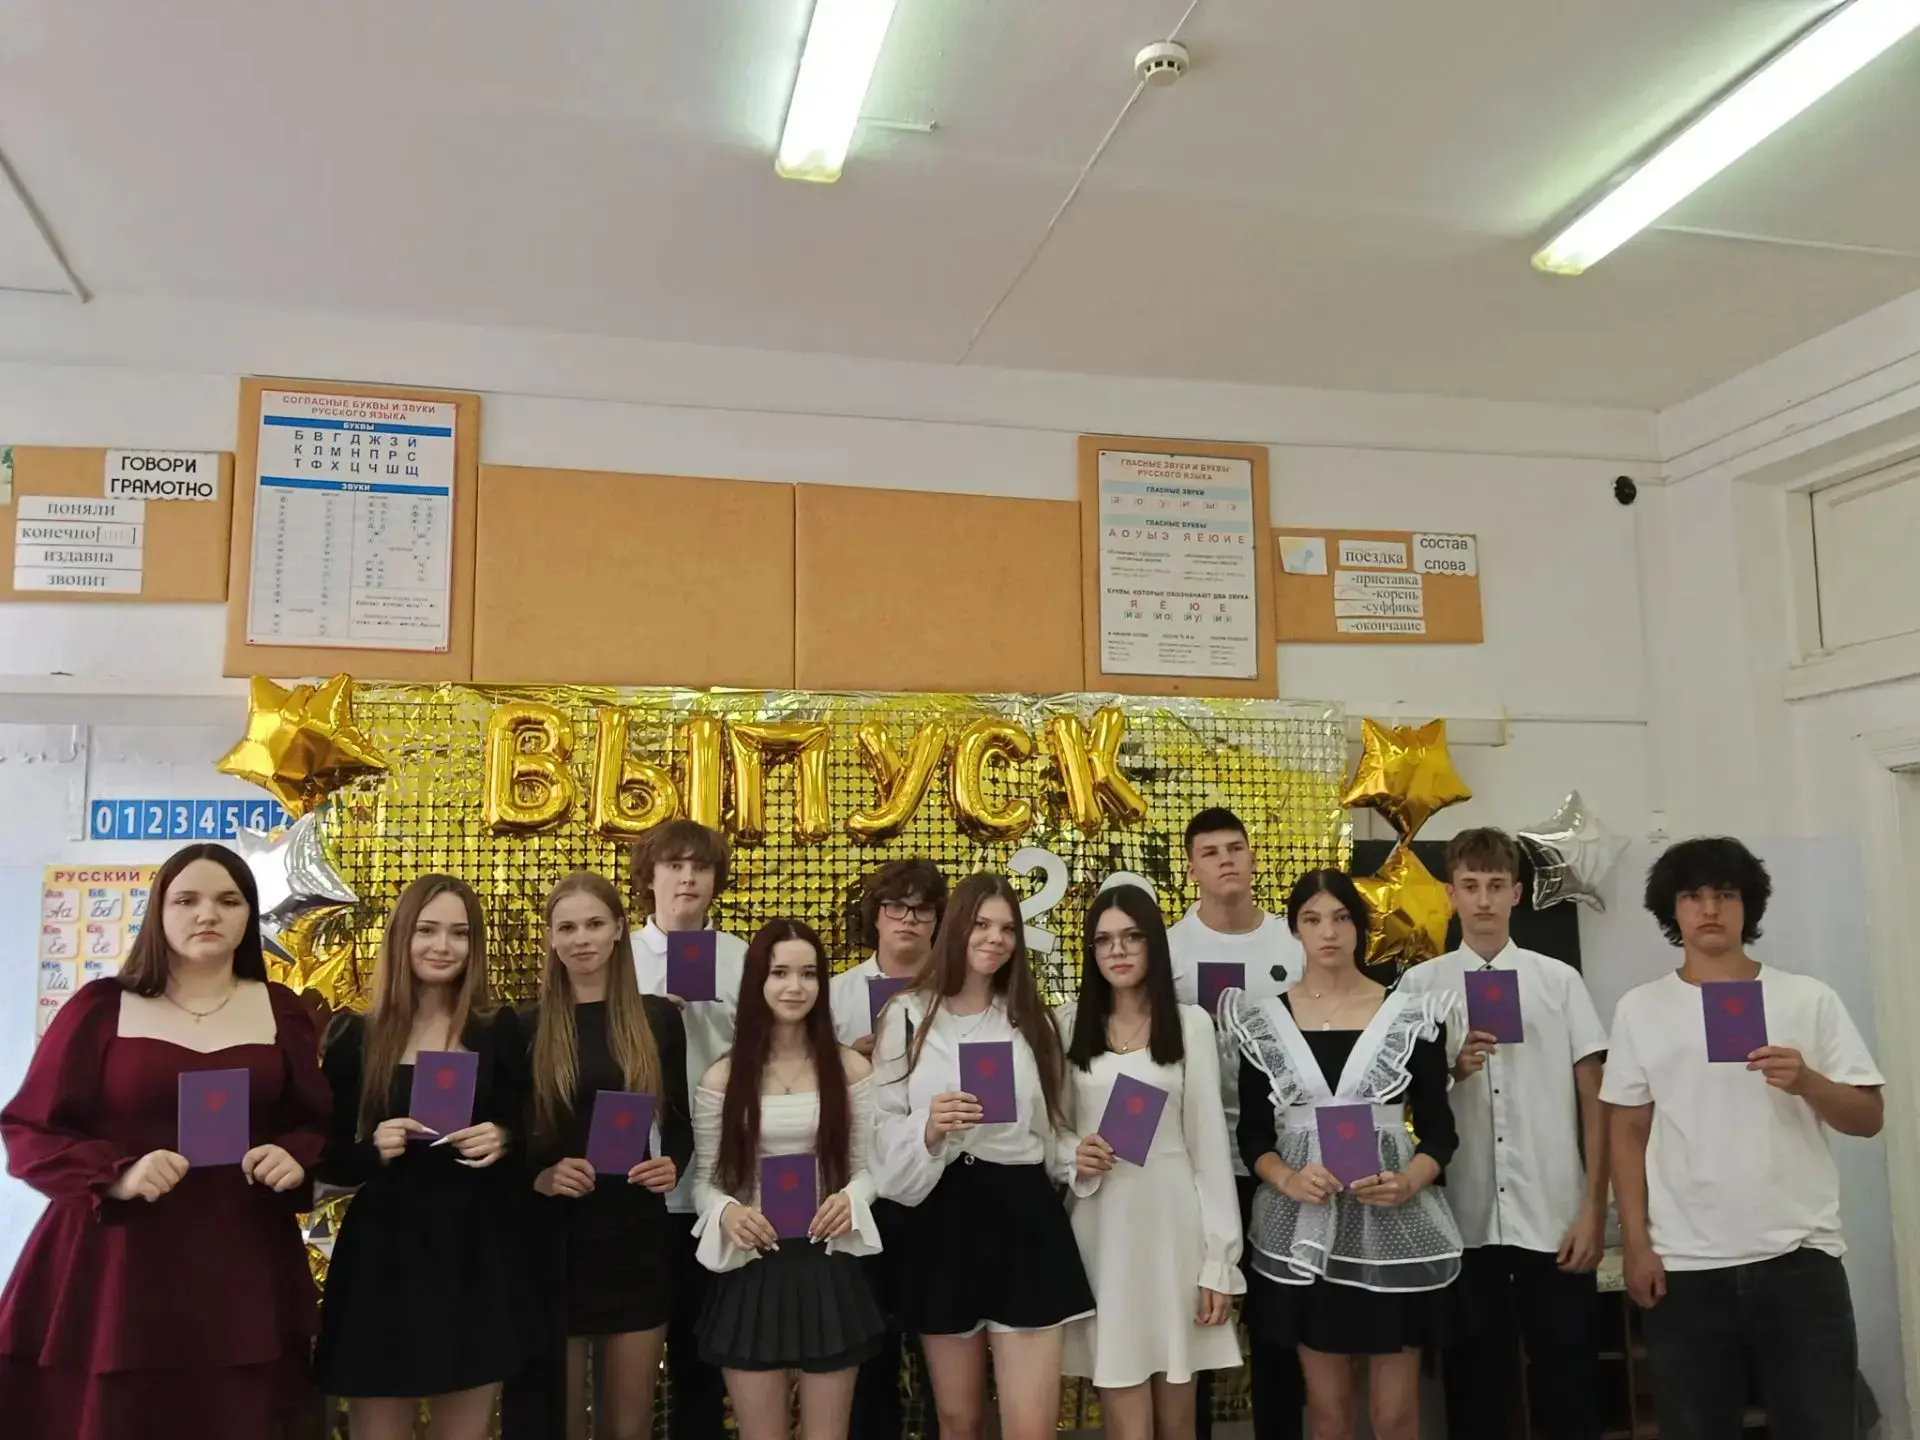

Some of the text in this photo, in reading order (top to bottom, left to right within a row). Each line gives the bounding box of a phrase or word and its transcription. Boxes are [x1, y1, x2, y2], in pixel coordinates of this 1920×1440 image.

[283, 396, 349, 408] СОГЛАСНЫЕ
[352, 400, 389, 410] БУКВЫ
[402, 403, 436, 414] ЗВУКИ
[312, 407, 406, 420] РУССКОГО ЯЗЫКА
[343, 422, 374, 431] БУКВЫ
[294, 430, 417, 448] Б В Г Д Ж З Й
[294, 444, 416, 462] К Л М Н П Р С
[121, 456, 196, 474] ГОВОРИ
[294, 458, 418, 476] Т Ф Х Ц Ч Ш Щ
[1121, 458, 1162, 468] ГЛАСНЫЕ
[1164, 461, 1190, 470] ЗВУКИ
[1200, 464, 1230, 472] БУКВЫ
[1137, 470, 1212, 481] РУССКОГО ЯЗЫКА
[110, 478, 213, 497] ГРАМОТНО
[341, 482, 370, 492] ЗВУКИ
[1146, 486, 1205, 496] ГЛАСНЫЕ ЗВУКИ
[47, 502, 116, 516] поняли
[1146, 519, 1180, 528] ГЛАСНЫЕ
[1109, 528, 1117, 537] А
[1122, 530, 1130, 538] О
[1136, 530, 1142, 538] У
[1148, 532, 1158, 540] Ы
[1184, 533, 1191, 542] Я
[1208, 534, 1220, 544] Ю
[1224, 535, 1231, 544] И
[1238, 535, 1244, 544] Е
[1420, 537, 1468, 550] состав
[44, 550, 114, 564] издавна
[1346, 550, 1404, 565] поездка
[1424, 558, 1466, 571] слова
[46, 574, 109, 586] звонит
[1351, 574, 1418, 587] -приставка
[1130, 600, 1138, 608] Я
[1190, 602, 1200, 611] Ю
[1220, 604, 1226, 612] Е
[1362, 601, 1419, 614] -суффикс
[484, 701, 1148, 846] ВЫПУСК
